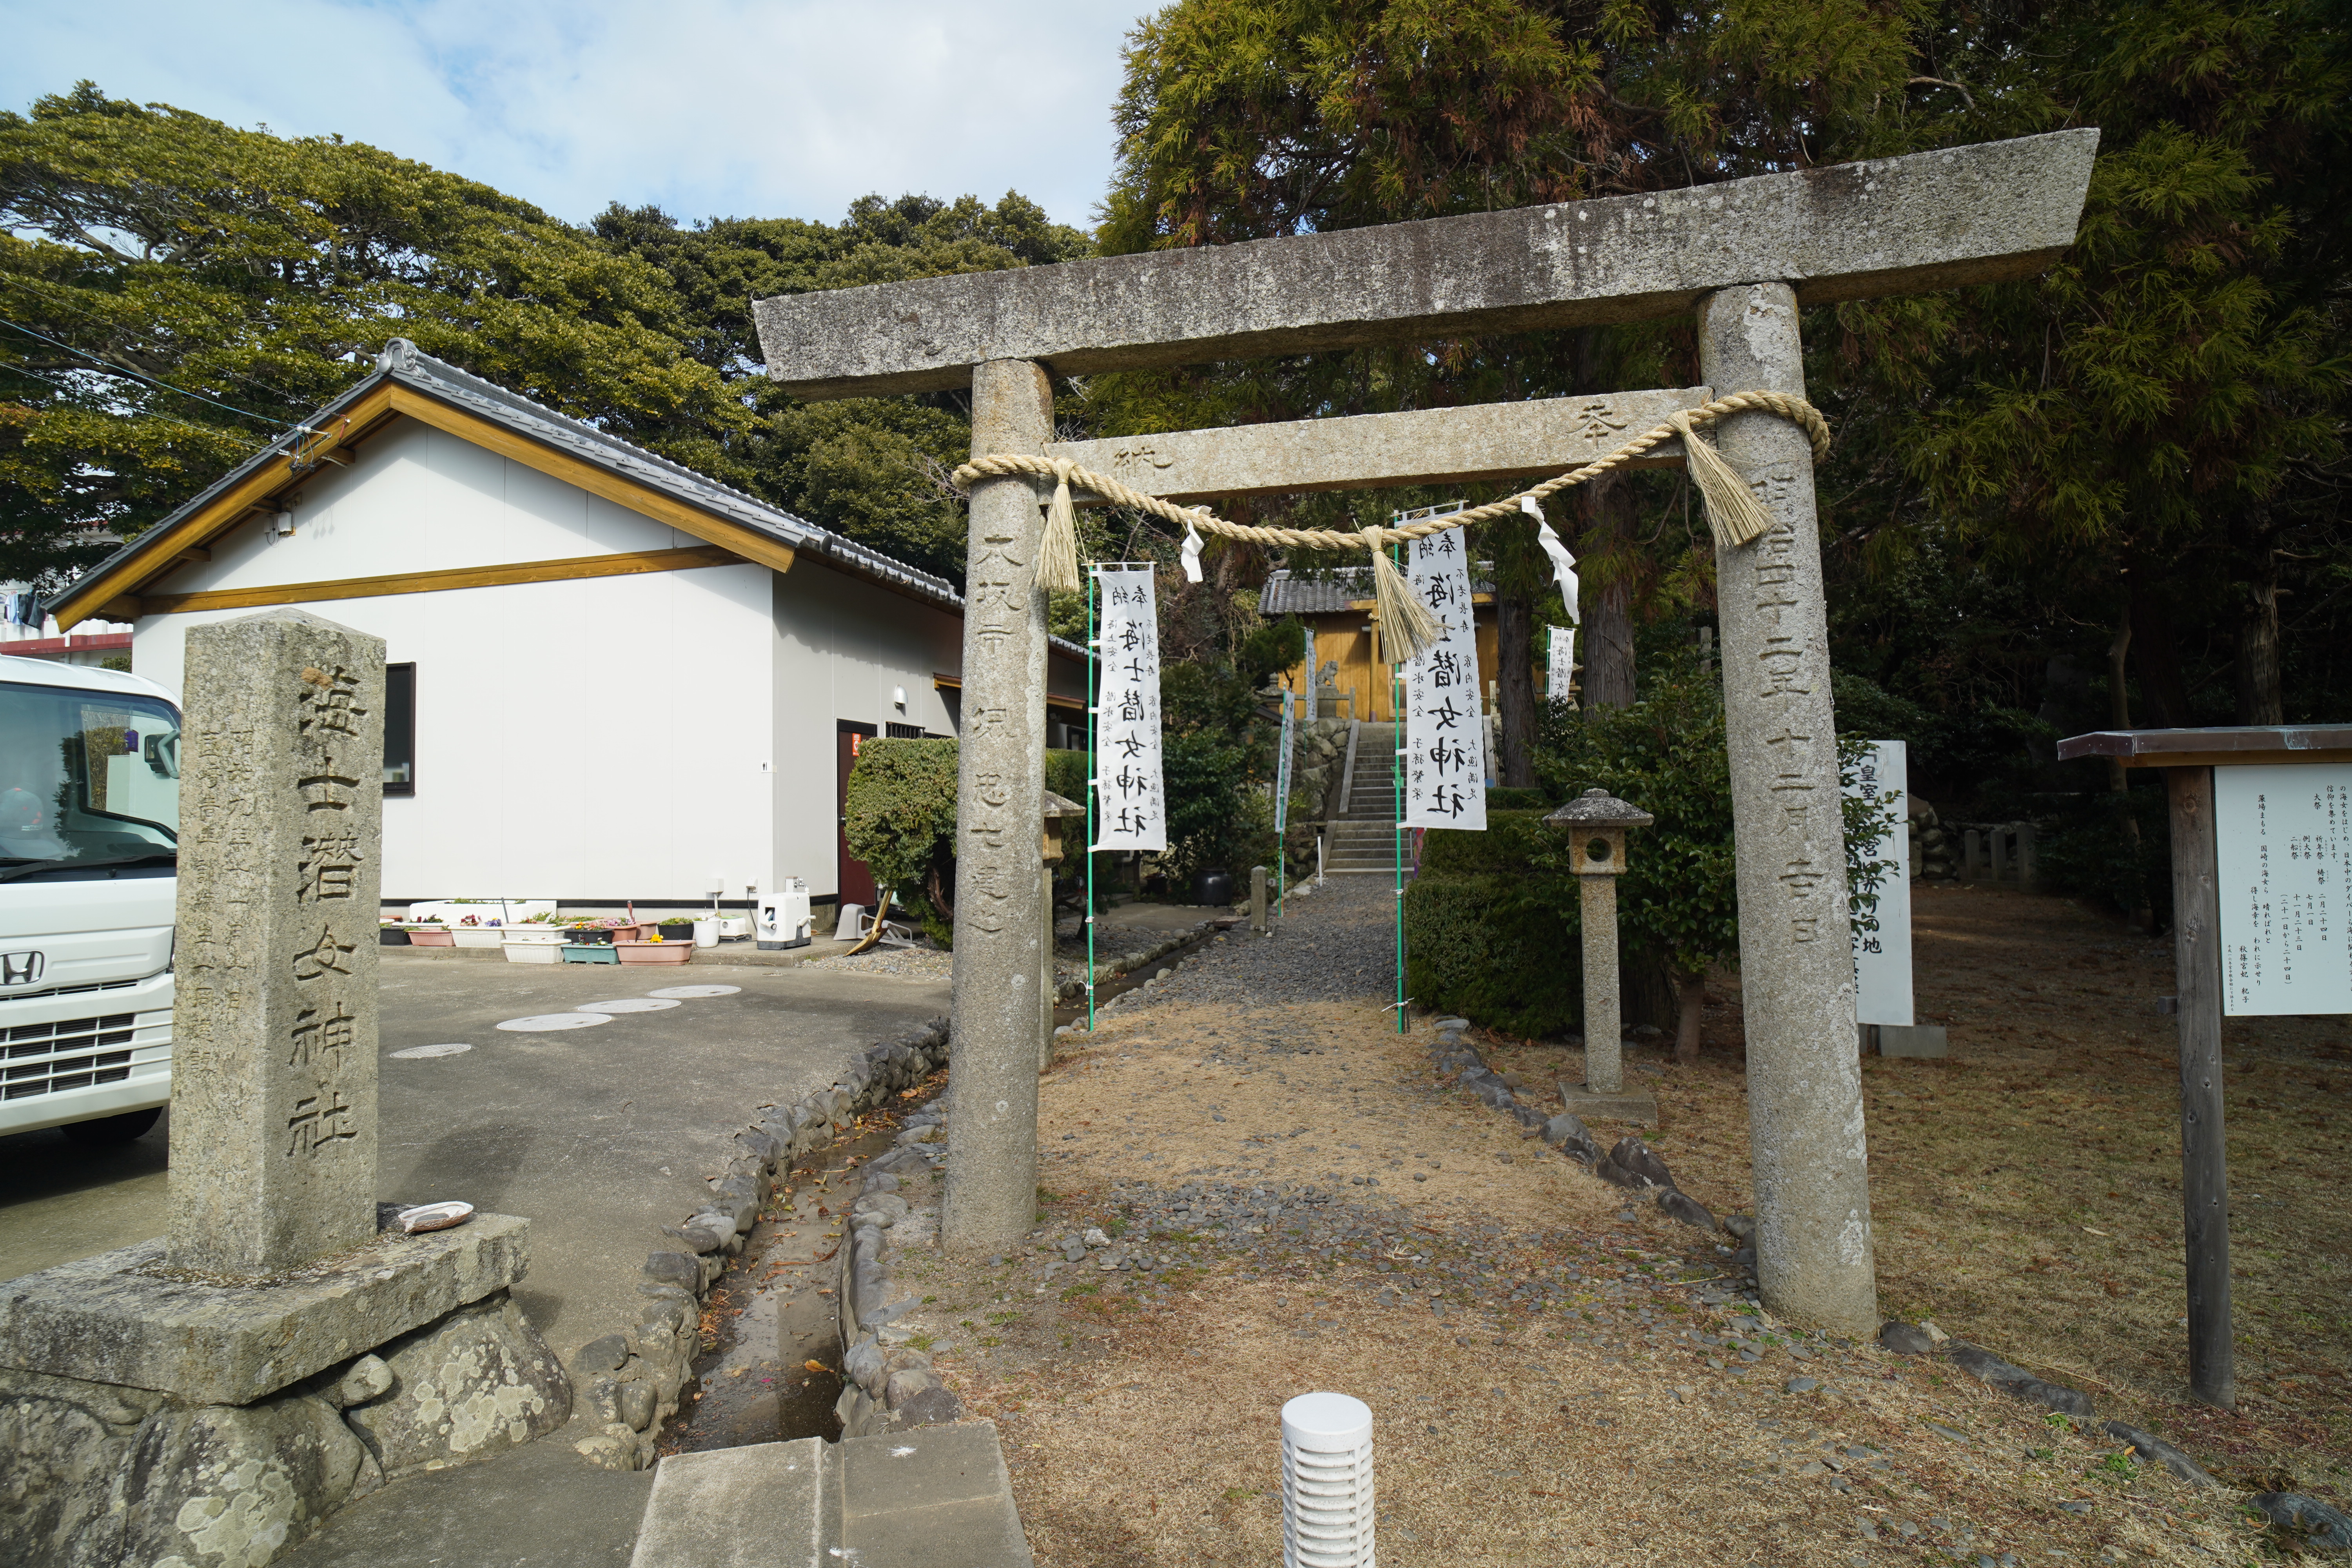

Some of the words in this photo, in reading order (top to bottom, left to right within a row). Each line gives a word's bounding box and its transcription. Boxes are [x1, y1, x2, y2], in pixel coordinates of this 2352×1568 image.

[1566, 405, 1628, 450] 奉
[2258, 794, 2266, 835] 藻場まもる
[2327, 785, 2338, 863] 信仰を集めています。
[2290, 836, 2299, 860] 二船祭
[2303, 835, 2311, 860] 例大祭
[2314, 793, 2322, 809] 大祭
[2319, 893, 2327, 941] 二月二十四日
[2261, 845, 2269, 894] 国崎の海女ら
[287, 664, 368, 1159] 海士潜女神社
[2250, 886, 2259, 927] 得し海幸を
[2262, 903, 2271, 944] 晴ればれと
[2293, 893, 2302, 951] 十一月二十三日
[2280, 894, 2292, 984] （二十一日から二十四日）
[2239, 945, 2248, 978] 秋篠宮妃
[2241, 987, 2249, 1003] 紀子
